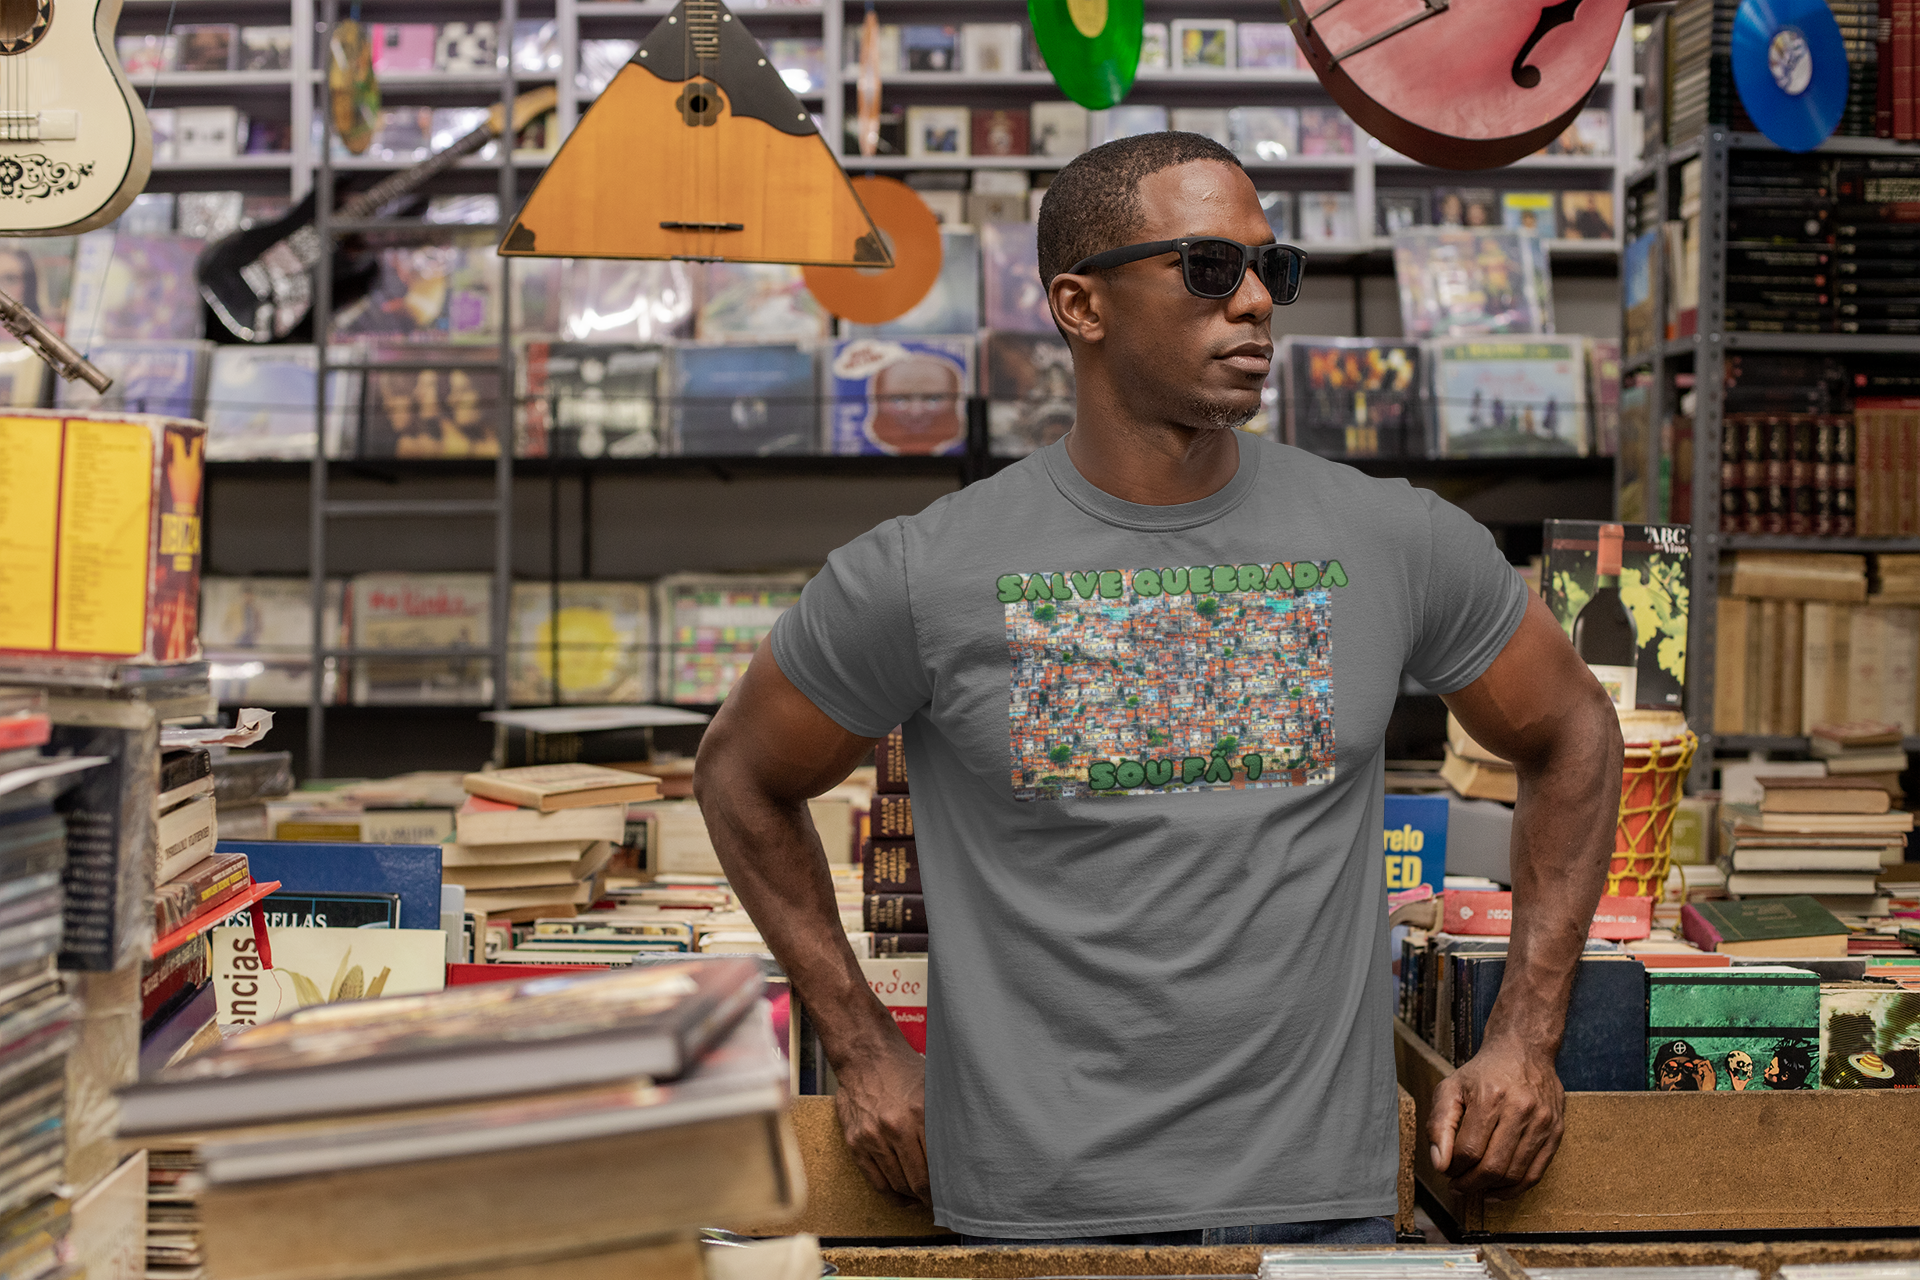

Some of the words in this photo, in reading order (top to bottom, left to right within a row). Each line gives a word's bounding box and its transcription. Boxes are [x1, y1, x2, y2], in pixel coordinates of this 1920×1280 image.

[997, 569, 1123, 603] SALVE
[1132, 560, 1349, 597] QUEBRADA
[1088, 759, 1174, 790] SOU
[1182, 749, 1233, 785] FÃ
[1241, 754, 1263, 781] 1
[880, 797, 889, 834] AMADO
[873, 847, 882, 884] AMADO
[1385, 855, 1422, 889] ED
[223, 937, 259, 1025] ncias
